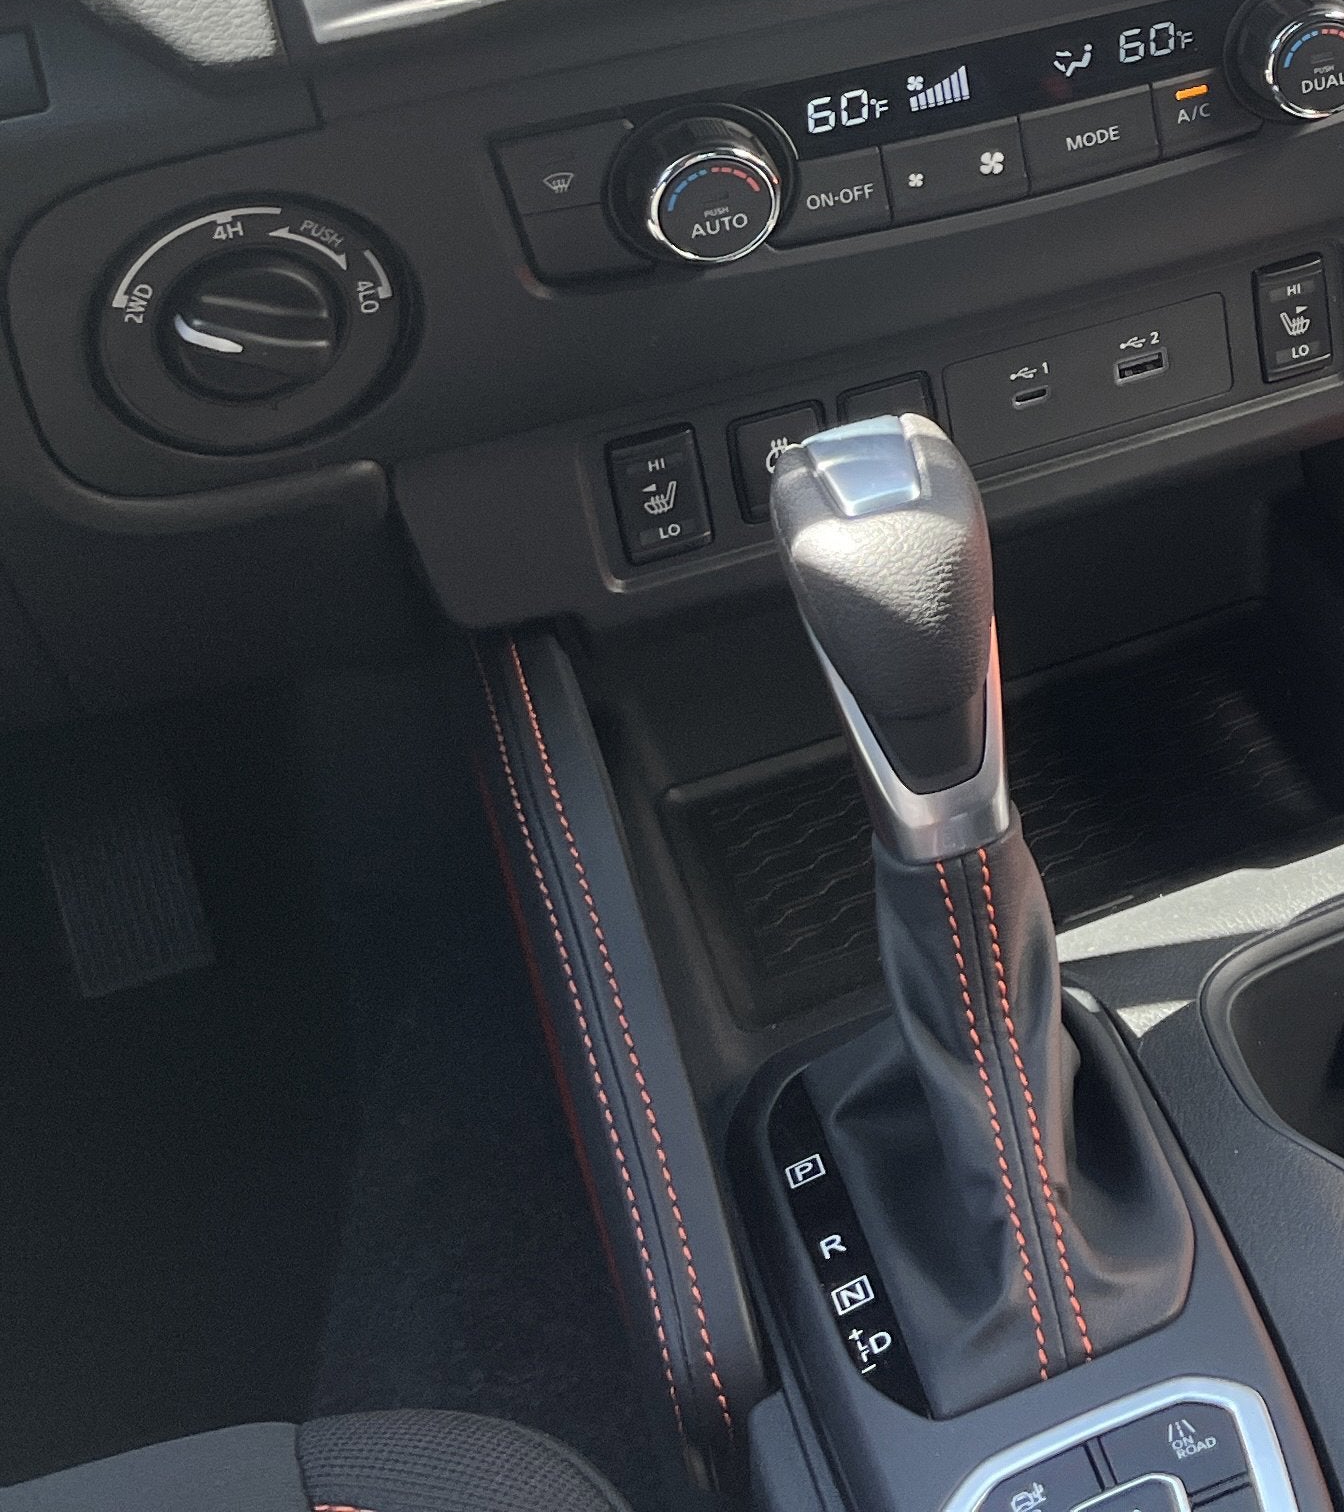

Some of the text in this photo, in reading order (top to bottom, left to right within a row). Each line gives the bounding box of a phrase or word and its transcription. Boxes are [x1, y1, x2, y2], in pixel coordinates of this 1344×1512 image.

[1176, 102, 1211, 125] A/C
[1065, 125, 1121, 152] MODE
[806, 182, 875, 210] ON-OFF
[703, 205, 730, 219] PUSH
[212, 220, 244, 241] 4H
[299, 219, 345, 248] PUSH
[690, 212, 749, 240] AUTO
[356, 279, 379, 314] 4LO
[1286, 282, 1302, 297] HI
[124, 283, 154, 324] 2WD
[1149, 331, 1160, 345] 2
[1290, 343, 1310, 359] LO
[1041, 360, 1050, 375] 1
[647, 457, 666, 472] HI
[659, 523, 681, 539] LO
[819, 1234, 847, 1260] R
[840, 1281, 866, 1308] N
[868, 1331, 892, 1355] D
[1170, 1434, 1195, 1451] ON
[1176, 1437, 1217, 1461] ROAD
